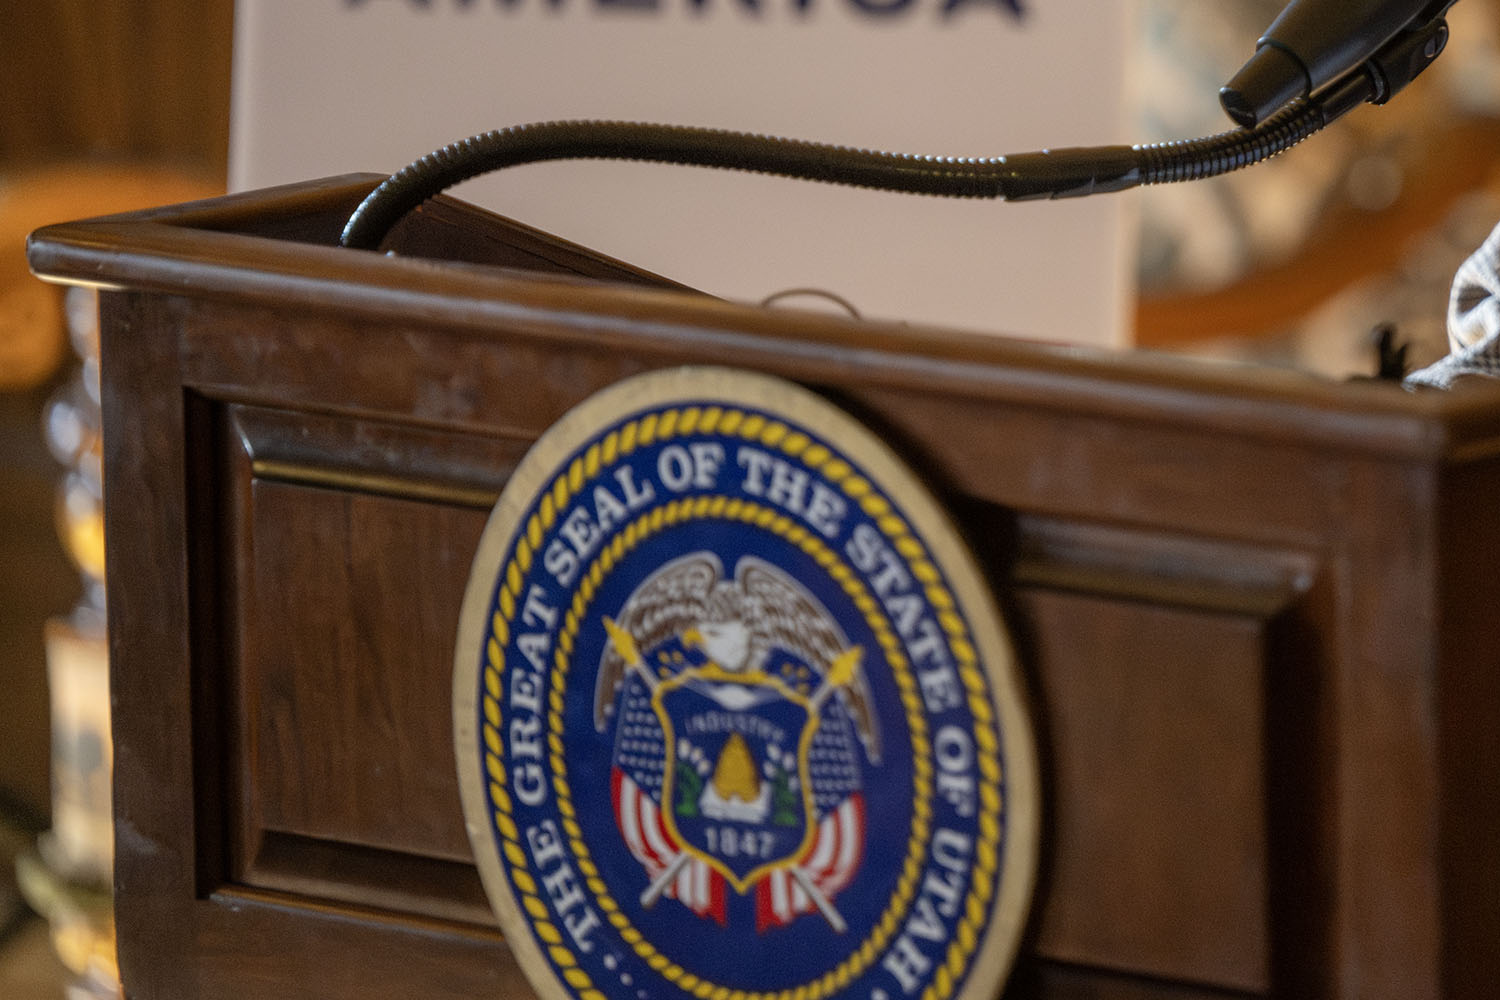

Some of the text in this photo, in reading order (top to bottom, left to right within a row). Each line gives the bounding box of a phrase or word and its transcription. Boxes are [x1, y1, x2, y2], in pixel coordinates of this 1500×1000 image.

[510, 443, 976, 991] THE GREAT SEAL OF THE STATE OF UTAH
[704, 826, 776, 858] 1847
